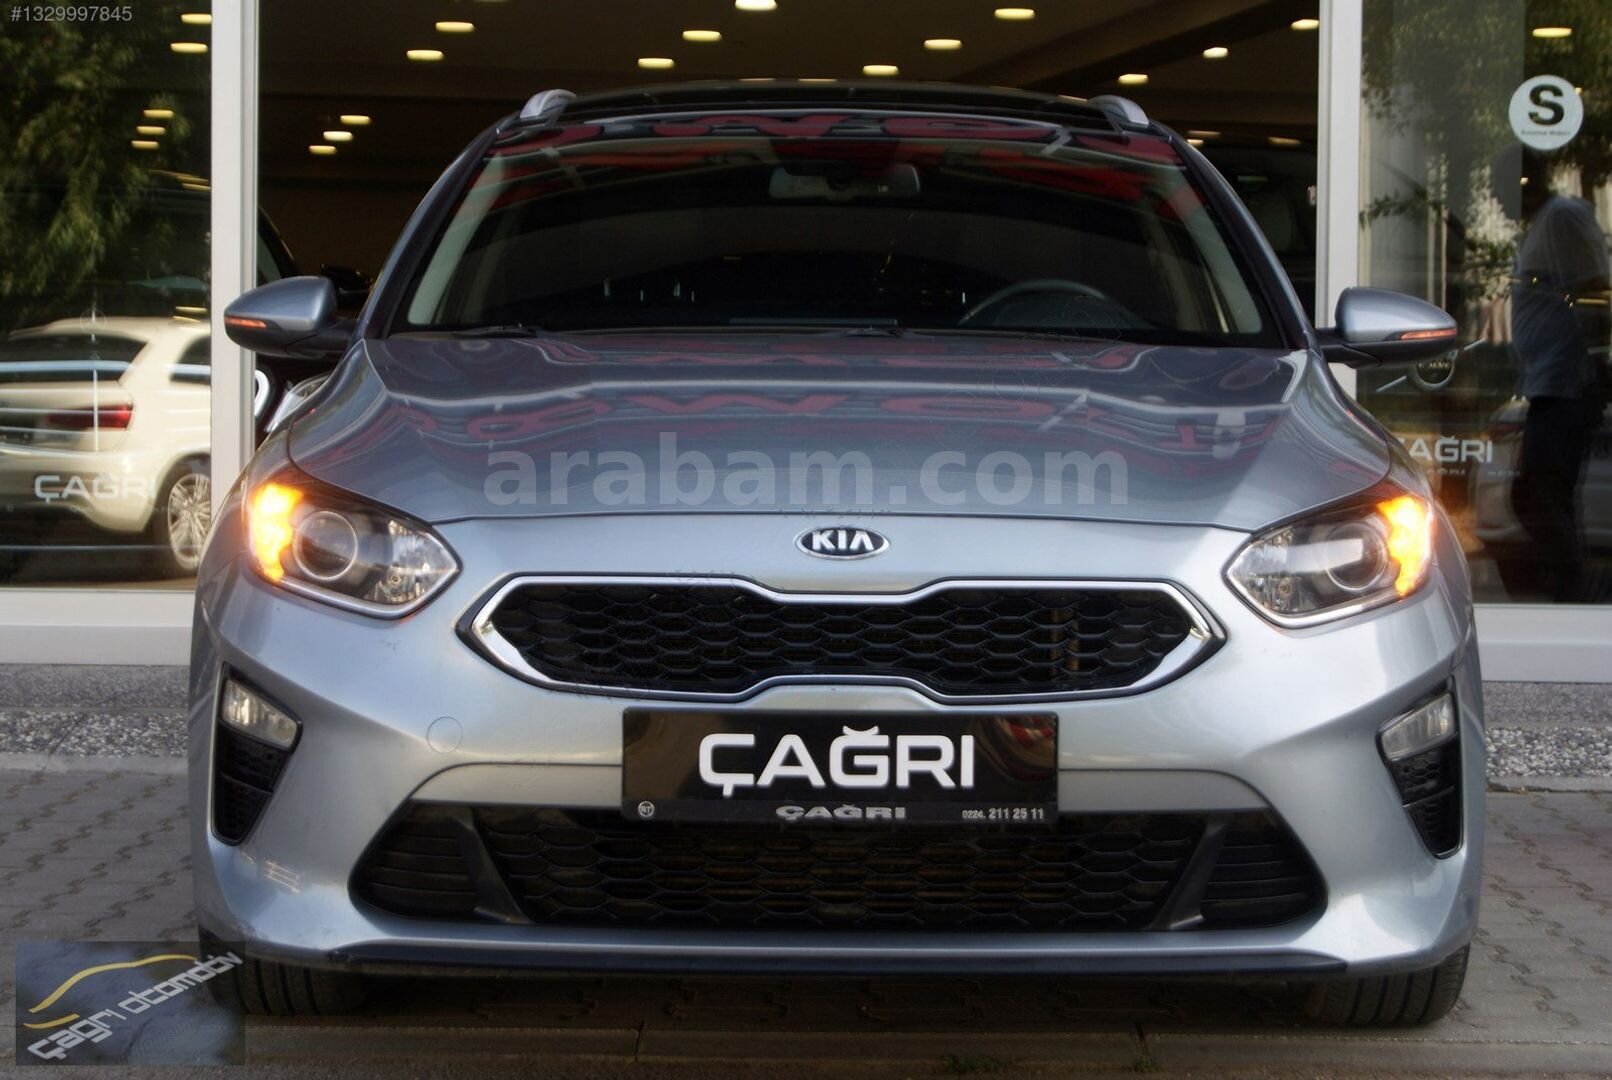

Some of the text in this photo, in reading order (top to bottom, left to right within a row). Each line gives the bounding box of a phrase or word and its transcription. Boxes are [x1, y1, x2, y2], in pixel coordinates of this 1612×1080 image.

[1528, 84, 1565, 126] S
[1398, 435, 1493, 463] AĞRI
[812, 529, 874, 551] KIA
[699, 725, 975, 797] ÇAĞRI
[775, 803, 906, 821] ÇAĞRI
[989, 807, 1009, 819] 211
[1013, 807, 1028, 819] 25
[1031, 807, 1044, 819] 11
